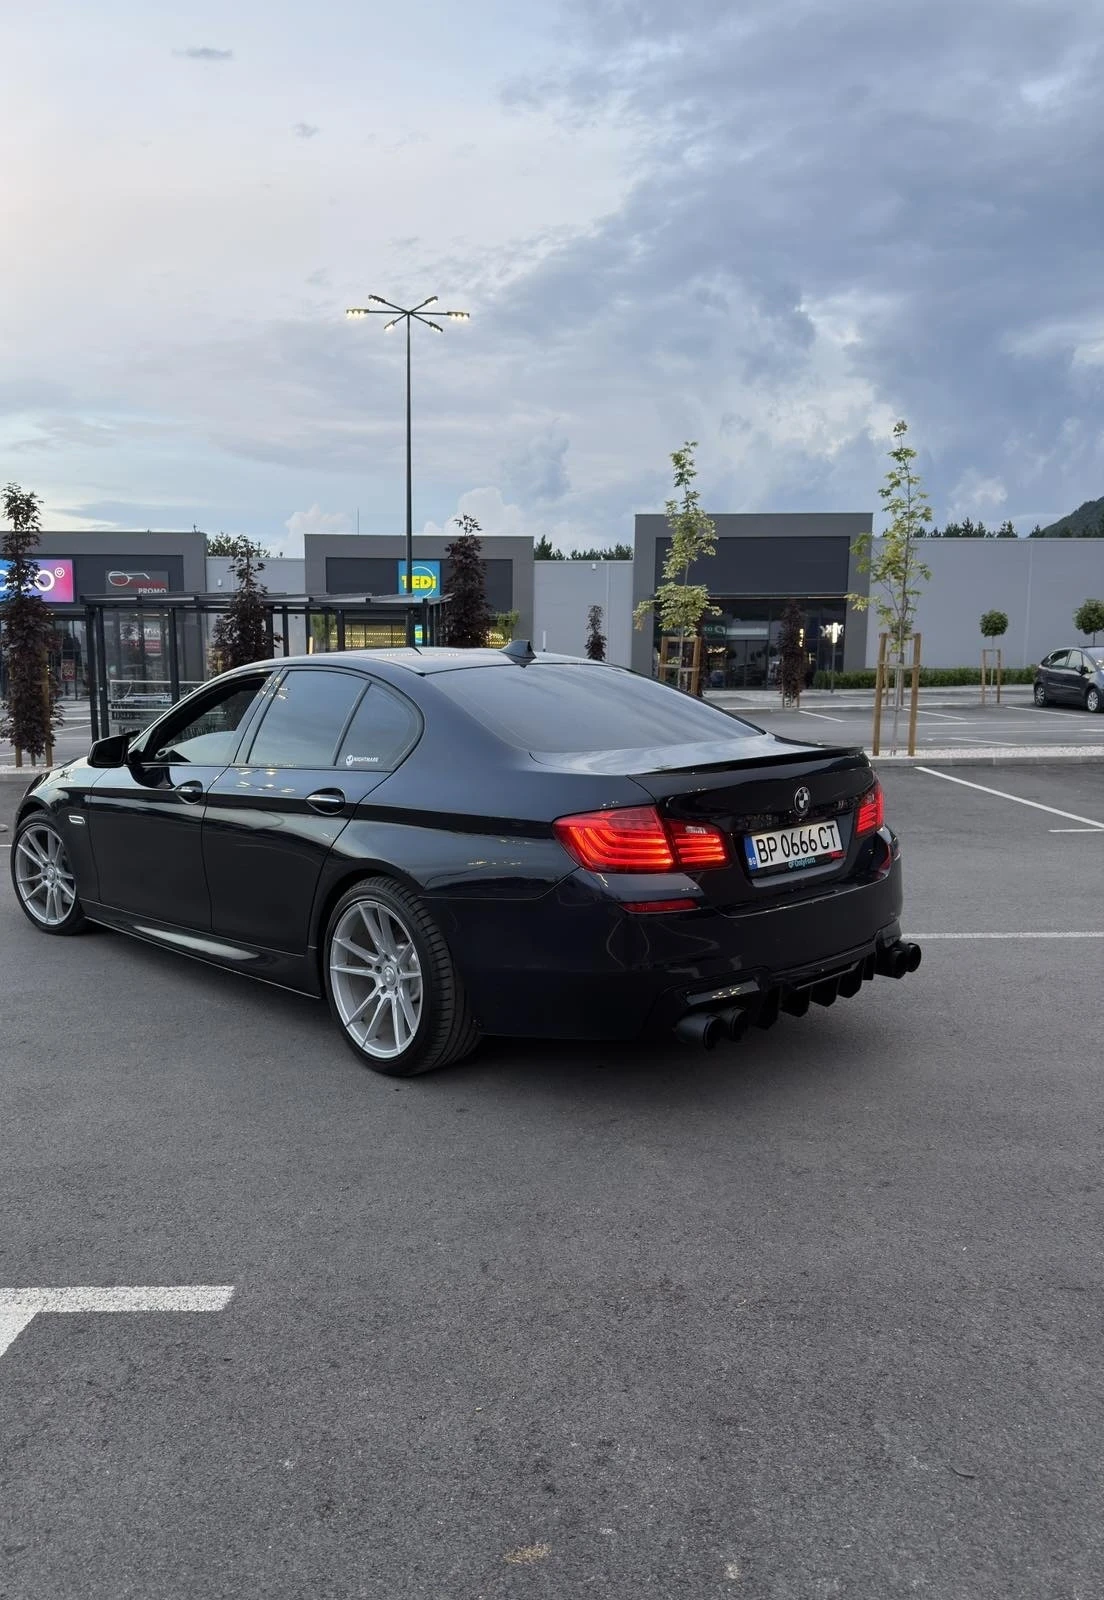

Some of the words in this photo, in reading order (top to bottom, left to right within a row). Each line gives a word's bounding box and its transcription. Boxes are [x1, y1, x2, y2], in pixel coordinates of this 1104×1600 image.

[755, 837, 778, 863] BP
[780, 829, 818, 858] 0666
[818, 825, 836, 850] CT
